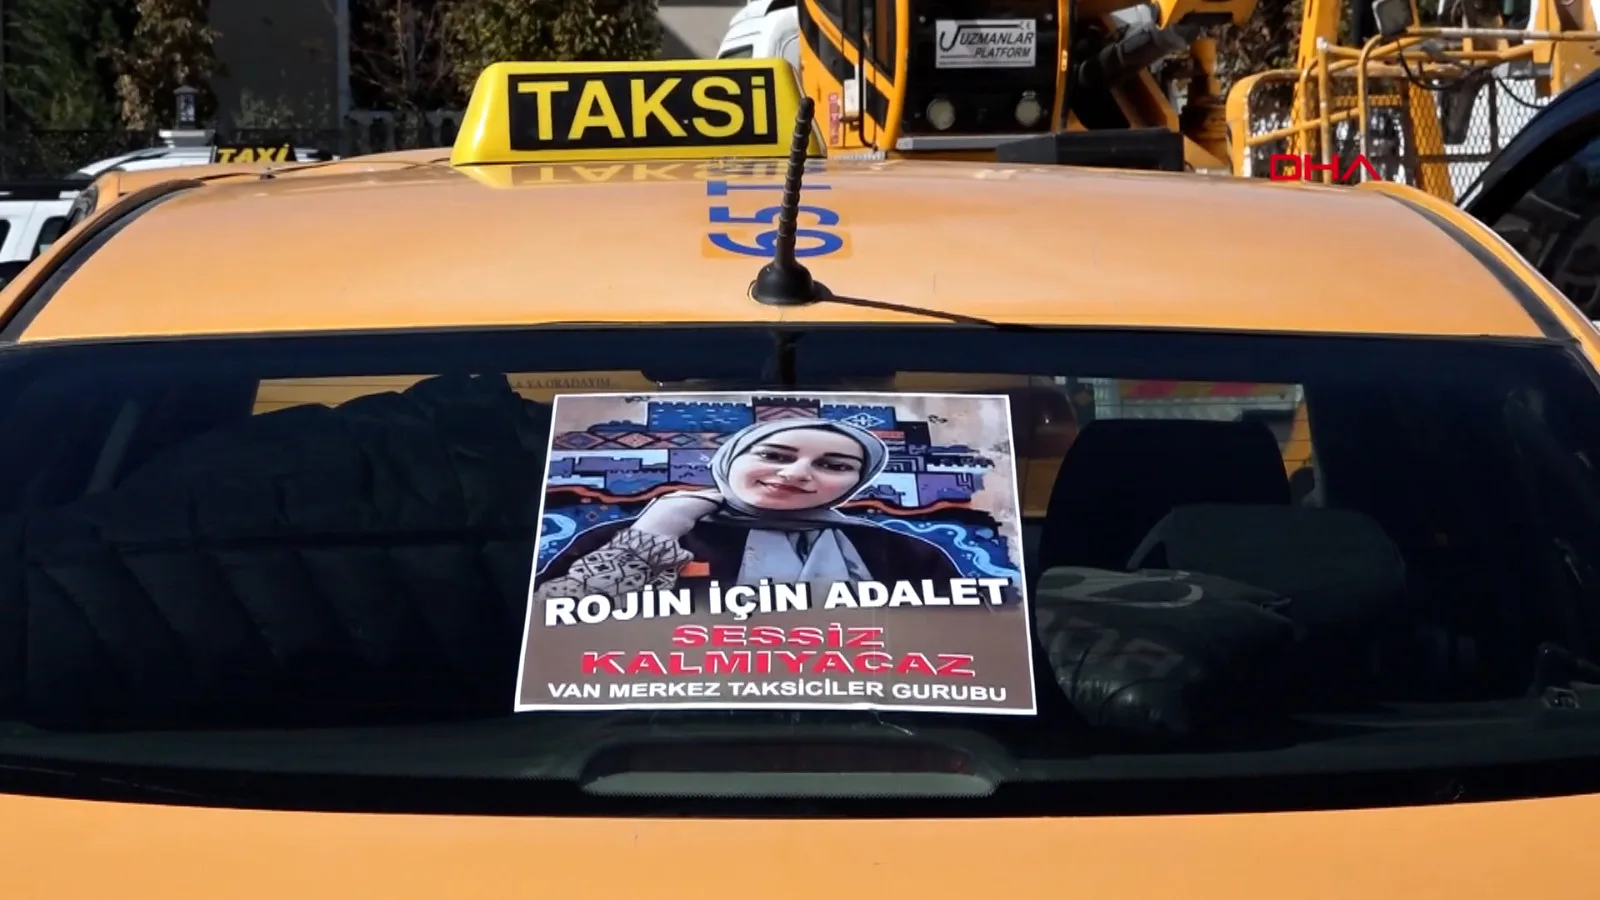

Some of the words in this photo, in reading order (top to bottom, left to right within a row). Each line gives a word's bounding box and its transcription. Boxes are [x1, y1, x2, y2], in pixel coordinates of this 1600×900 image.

[974, 46, 1031, 59] PLATFORM
[545, 585, 692, 627] ROJİN
[708, 578, 810, 621] İÇİN
[824, 577, 1010, 610] ADALET
[671, 622, 885, 648] SESSİZ
[580, 650, 976, 678] KALMIYACAZ
[547, 683, 601, 699] VAN
[608, 681, 721, 698] MERKEZ
[727, 678, 885, 697] TAKSİCİLER
[891, 682, 1007, 702] GURUBU
